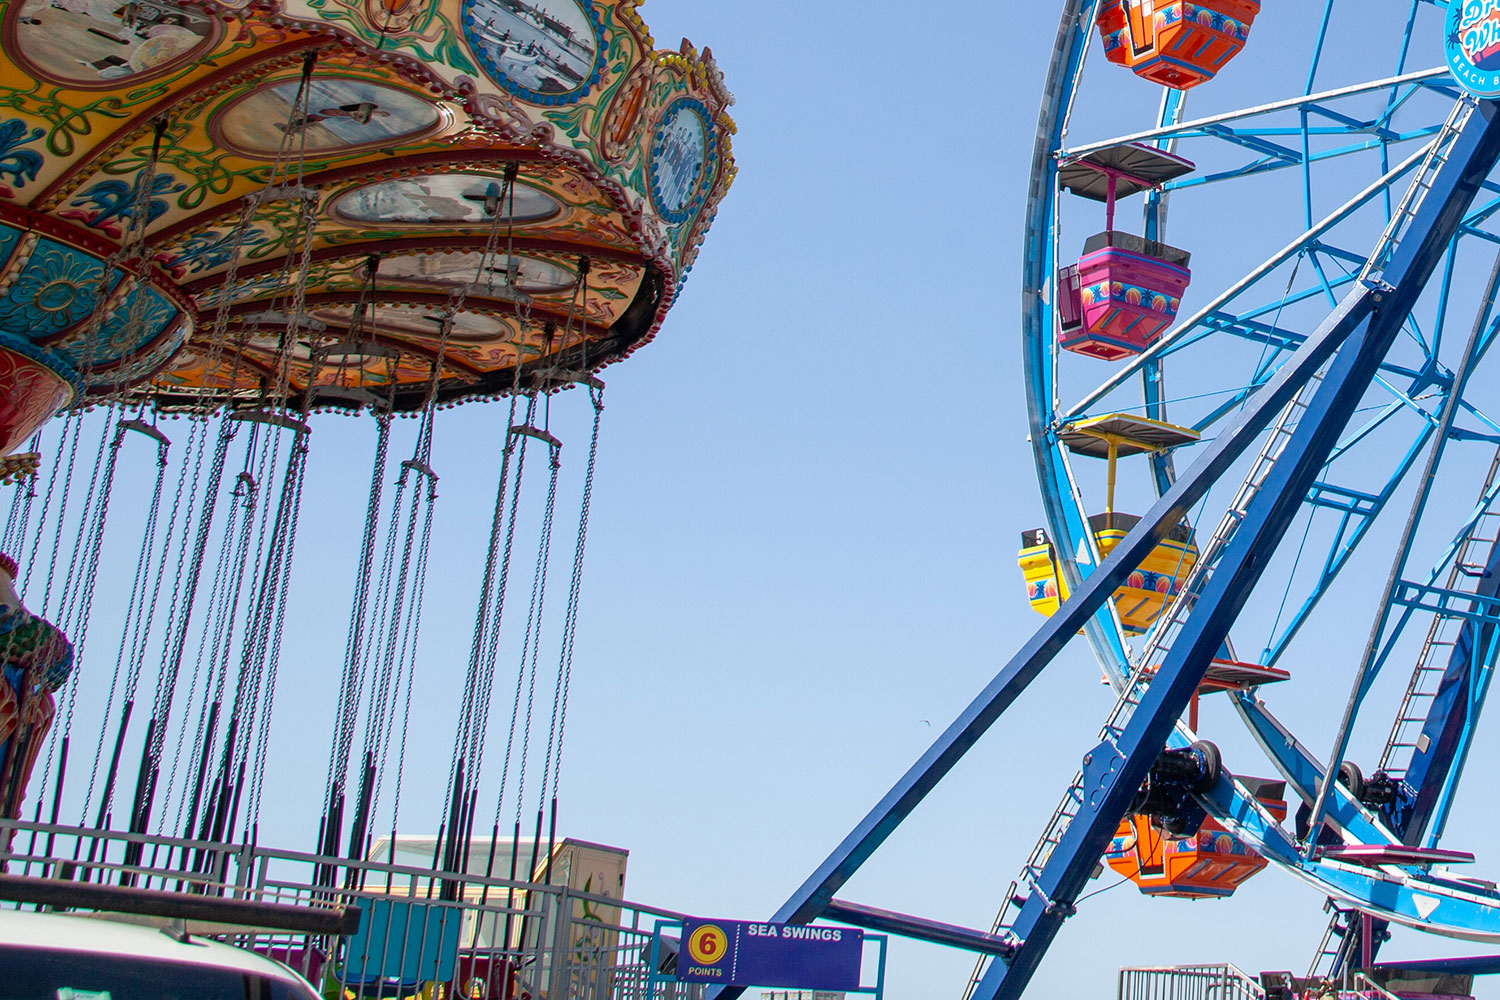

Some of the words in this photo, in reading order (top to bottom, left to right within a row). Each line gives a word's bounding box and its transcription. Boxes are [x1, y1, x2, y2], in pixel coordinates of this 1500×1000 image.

[1453, 54, 1486, 86] BEACH
[1035, 529, 1045, 544] 5
[747, 923, 778, 938] SEA
[782, 926, 843, 942] SWINGS
[698, 932, 717, 955] 6
[688, 966, 722, 977] POINTS
